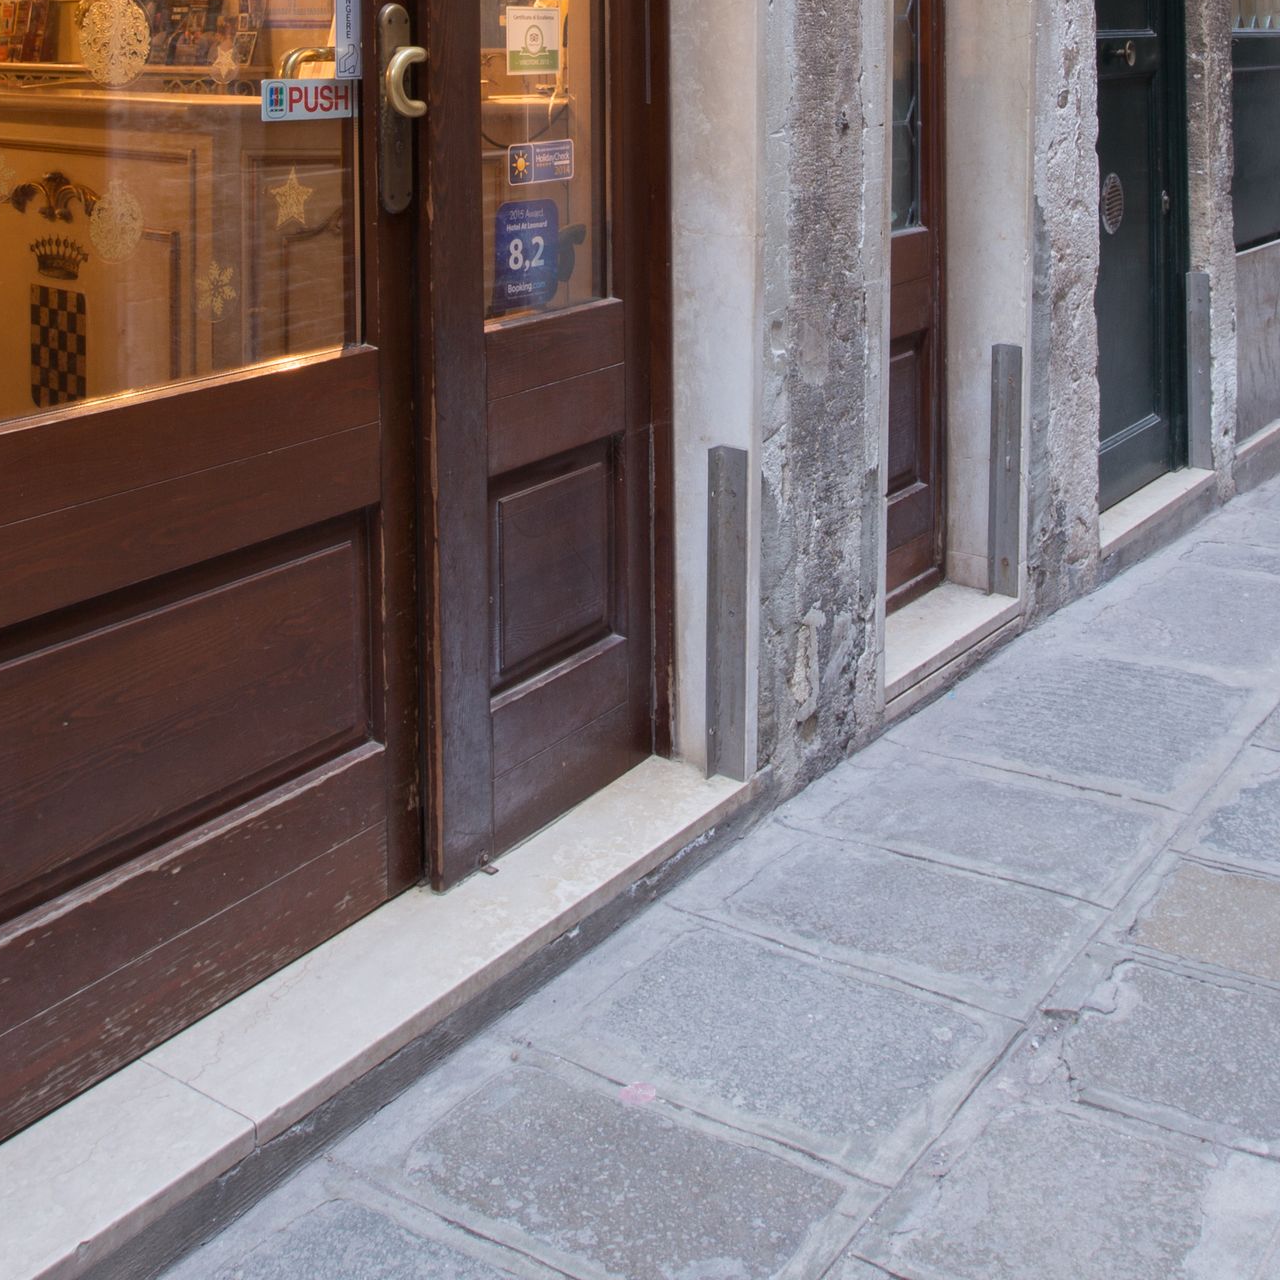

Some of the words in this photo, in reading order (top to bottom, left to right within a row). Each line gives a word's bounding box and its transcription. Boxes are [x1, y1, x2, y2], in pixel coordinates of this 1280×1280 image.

[288, 85, 349, 113] PUSH
[509, 210, 525, 221] 2015
[508, 235, 545, 271] 8,2
[507, 280, 546, 294] Booking.com
